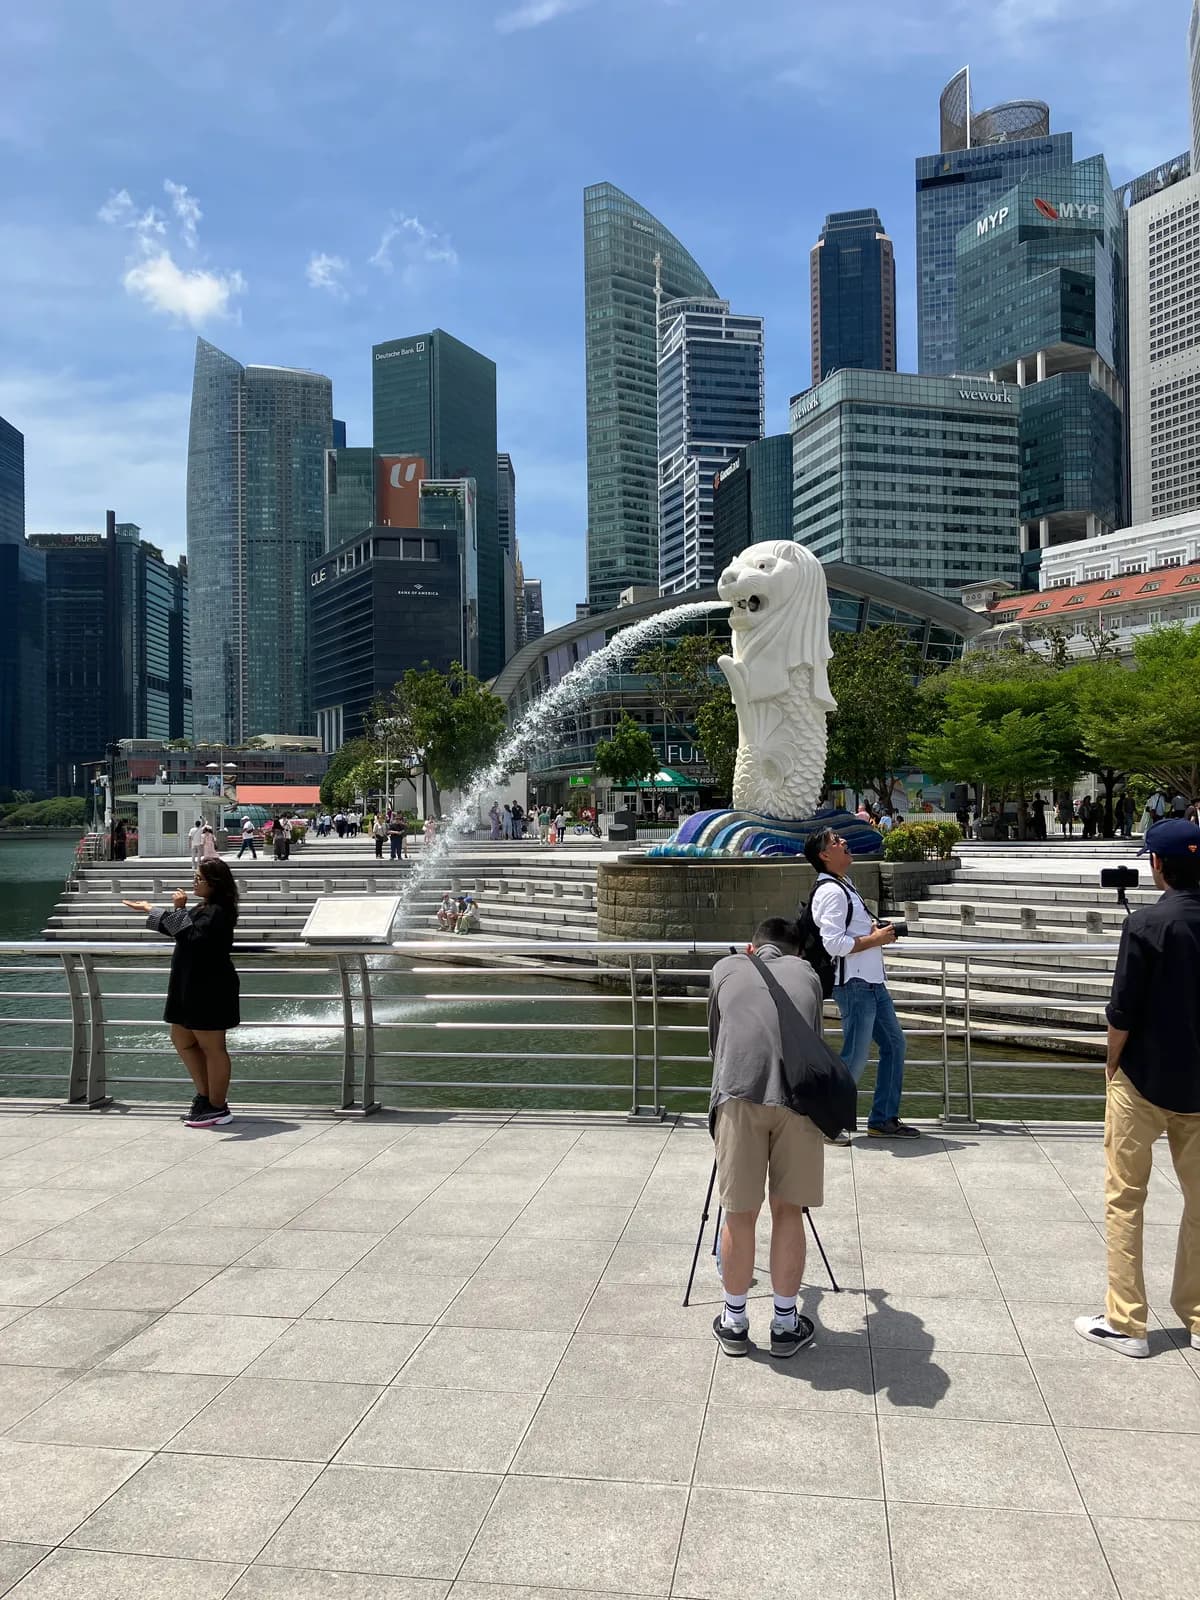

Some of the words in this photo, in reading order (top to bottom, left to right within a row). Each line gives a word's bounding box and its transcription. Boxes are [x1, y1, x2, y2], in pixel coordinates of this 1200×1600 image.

[1060, 202, 1099, 219] MYP
[977, 206, 1009, 236] MYP
[401, 348, 415, 356] Bank
[959, 388, 1012, 403] wework
[74, 535, 98, 543] MUFG
[311, 567, 326, 586] OUE
